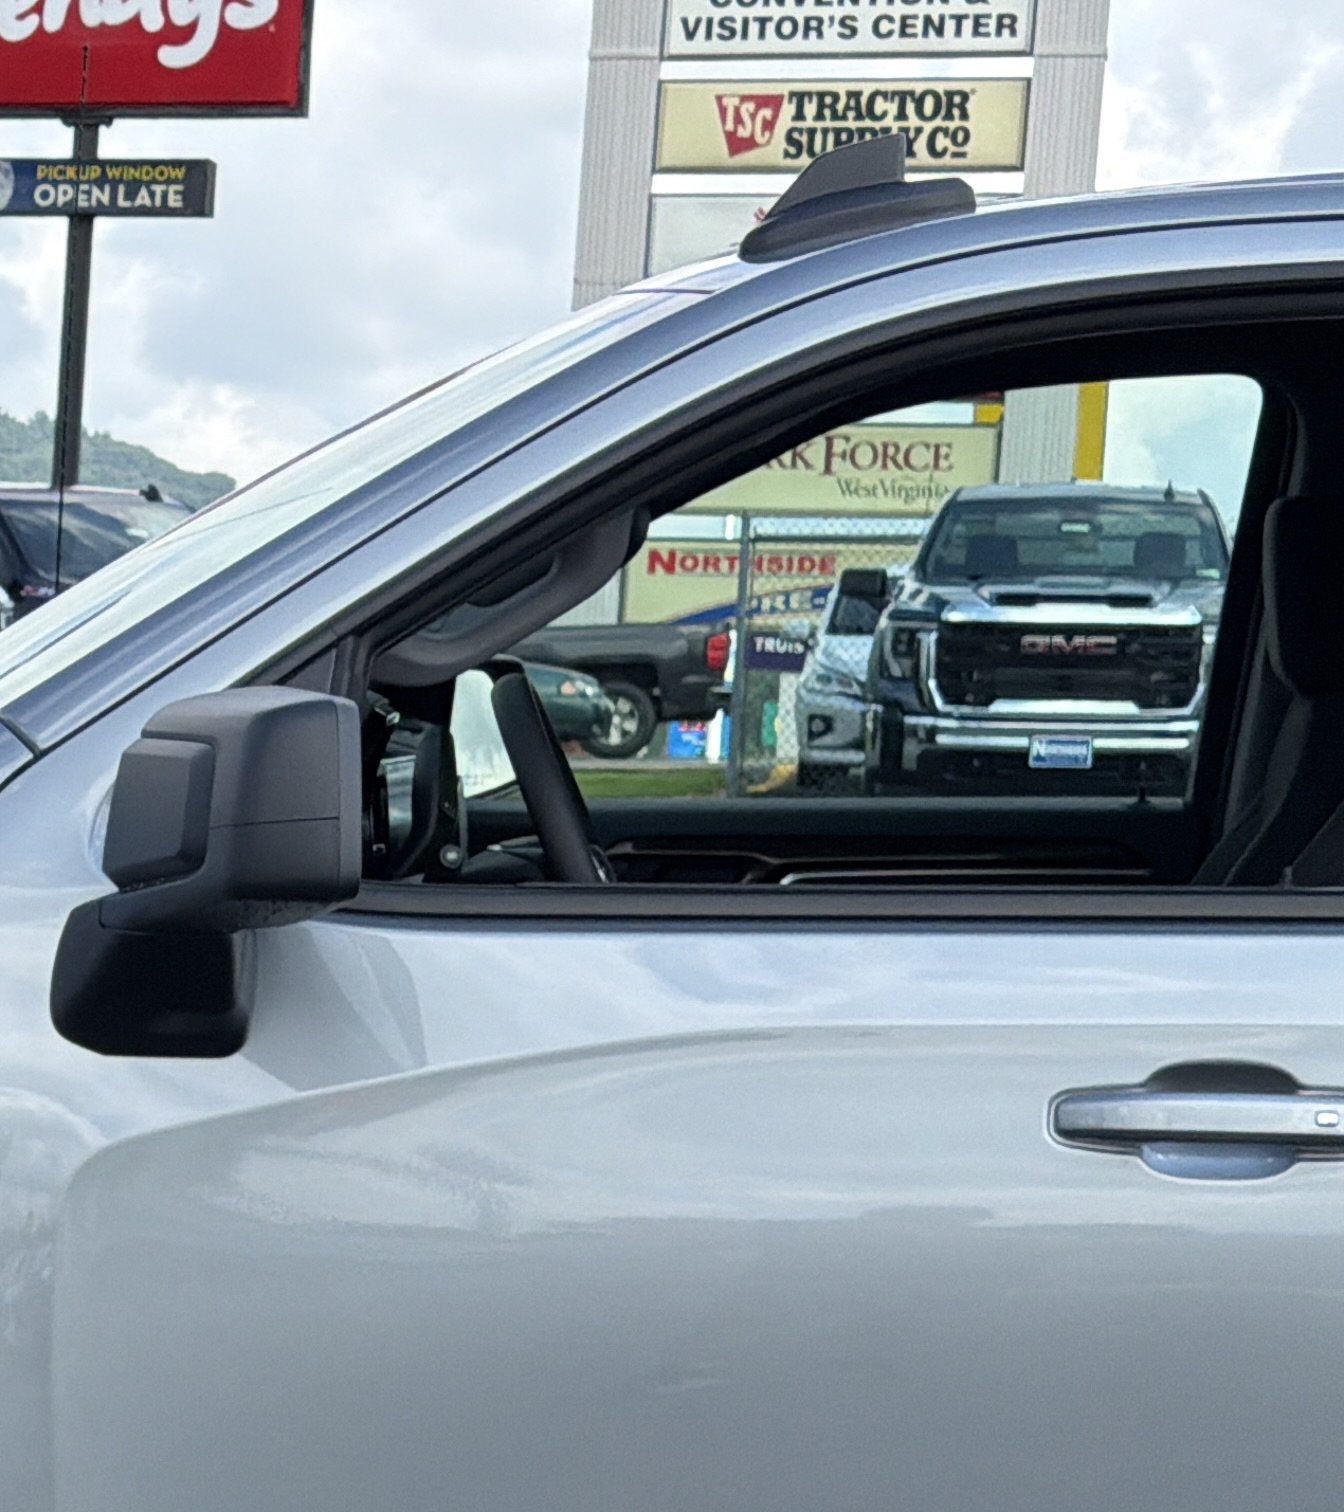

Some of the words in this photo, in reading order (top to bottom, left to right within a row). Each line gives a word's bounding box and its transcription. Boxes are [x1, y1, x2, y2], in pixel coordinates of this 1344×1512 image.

[680, 15, 859, 41] VISITOR'S
[872, 13, 1018, 39] CENTER
[787, 89, 970, 122] TRACTOR
[721, 97, 773, 145] TSC
[36, 165, 102, 181] PICKUP
[106, 165, 186, 181] WINDOW
[33, 183, 111, 208] OPEN
[117, 183, 185, 208] LATE
